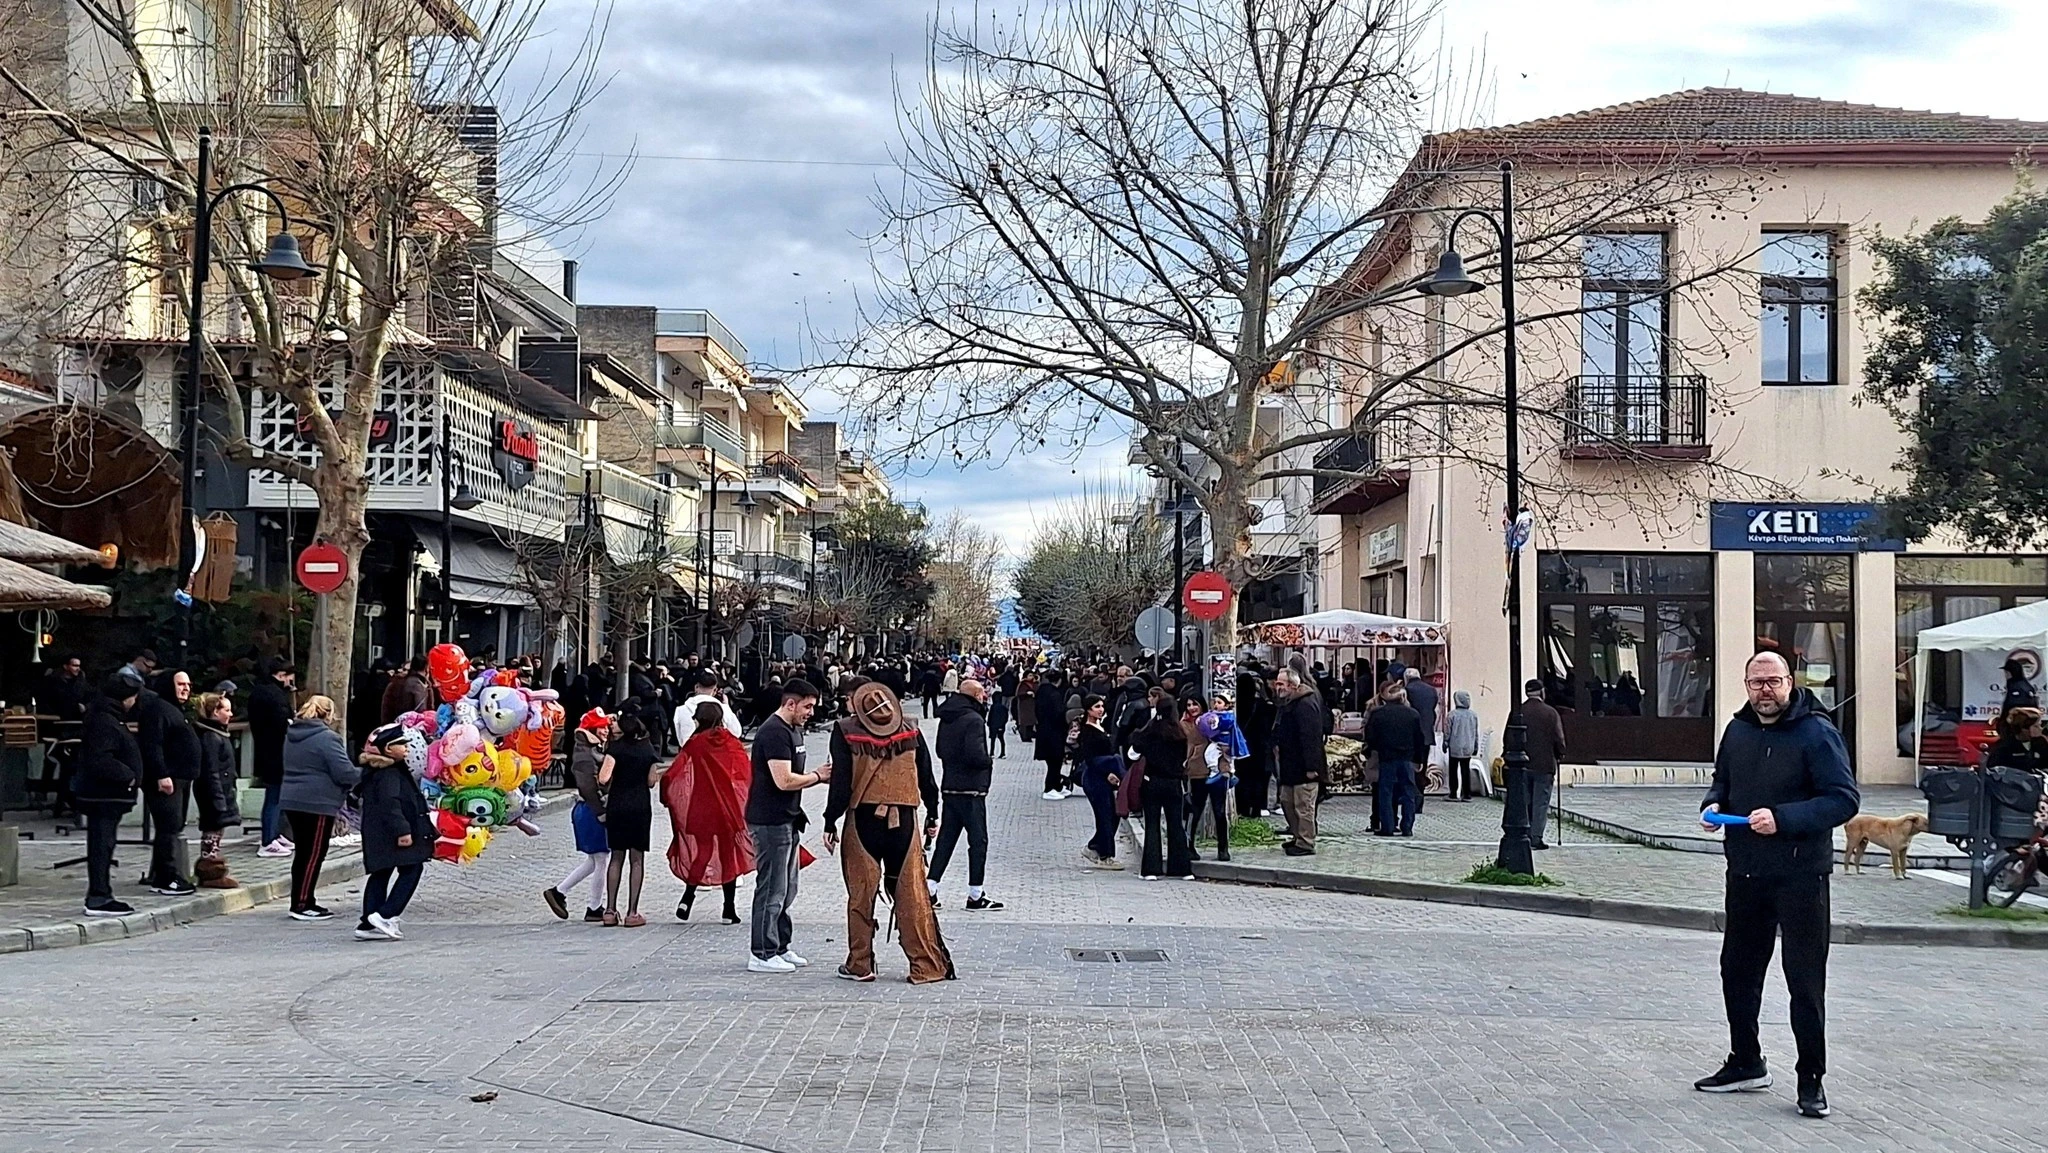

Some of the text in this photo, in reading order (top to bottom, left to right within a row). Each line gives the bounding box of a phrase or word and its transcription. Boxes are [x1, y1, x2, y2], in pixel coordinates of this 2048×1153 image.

[1748, 510, 1818, 533] ΚΕΠ
[1748, 534, 1777, 543] Κέντρο
[1778, 534, 1835, 544] Εξυπηρέτησης
